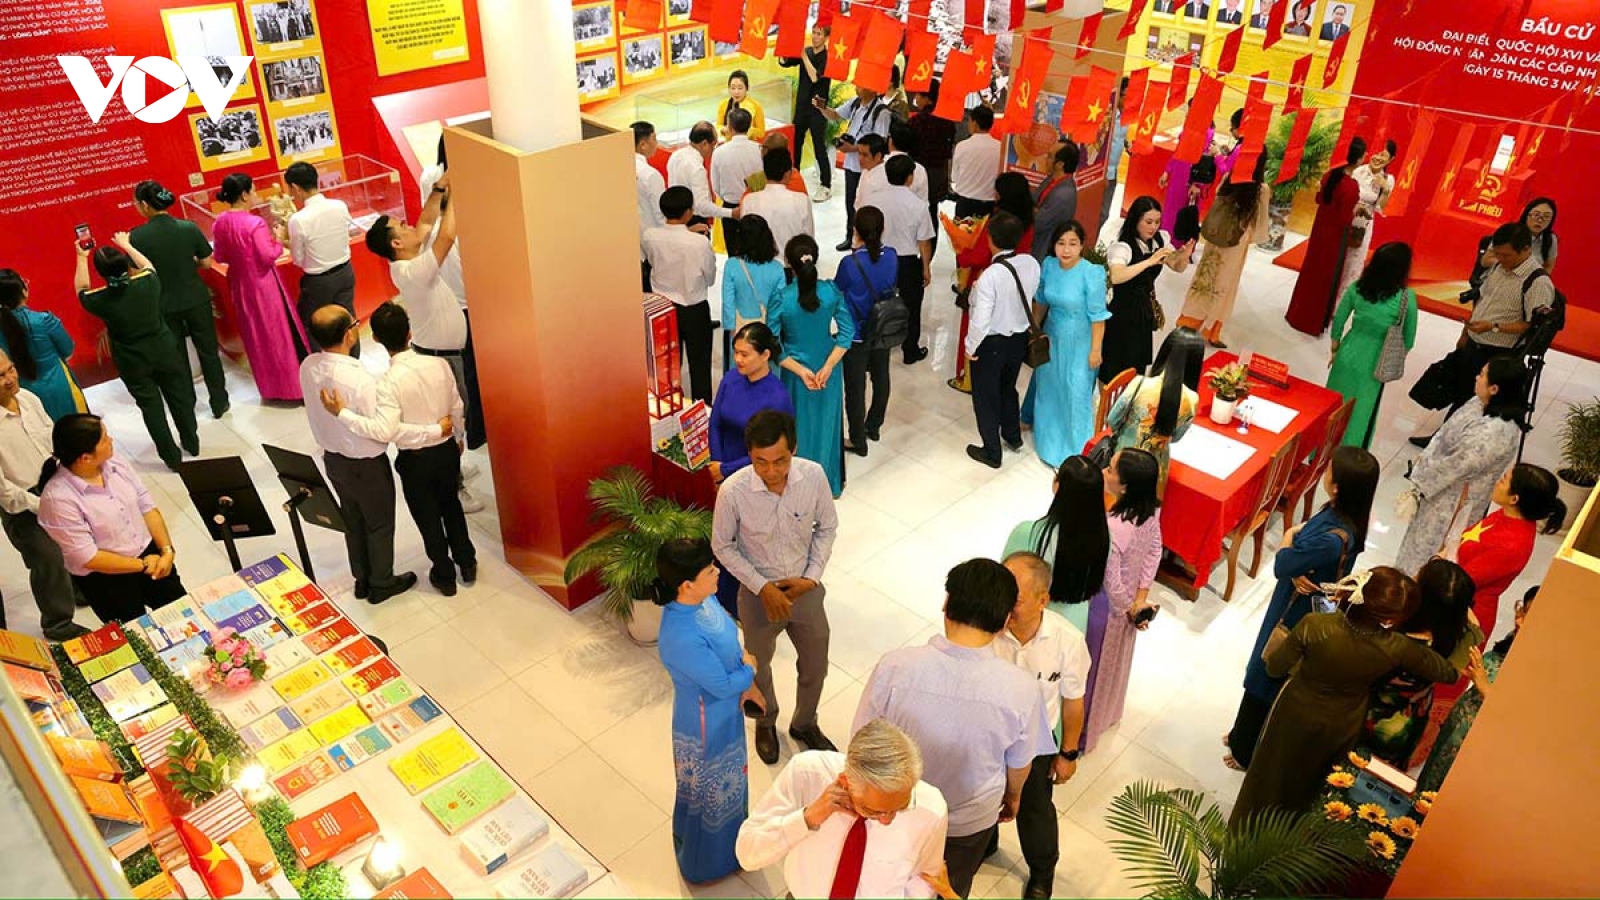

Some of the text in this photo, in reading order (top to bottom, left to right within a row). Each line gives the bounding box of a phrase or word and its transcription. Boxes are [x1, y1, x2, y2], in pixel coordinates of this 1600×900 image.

[1564, 22, 1596, 40] CỬ
[1393, 36, 1415, 50] HỘI
[1416, 40, 1451, 55] ĐỒNG
[1519, 57, 1546, 70] CÁC
[1547, 60, 1575, 75] CẤP
[1443, 30, 1464, 43] ĐẠI
[1496, 38, 1533, 52] QUỐC
[1535, 43, 1559, 58] HỘI
[1560, 48, 1583, 60] XVI
[1492, 67, 1504, 80] 15
[1507, 71, 1549, 87] THÁNG
[1550, 78, 1560, 89] 3
